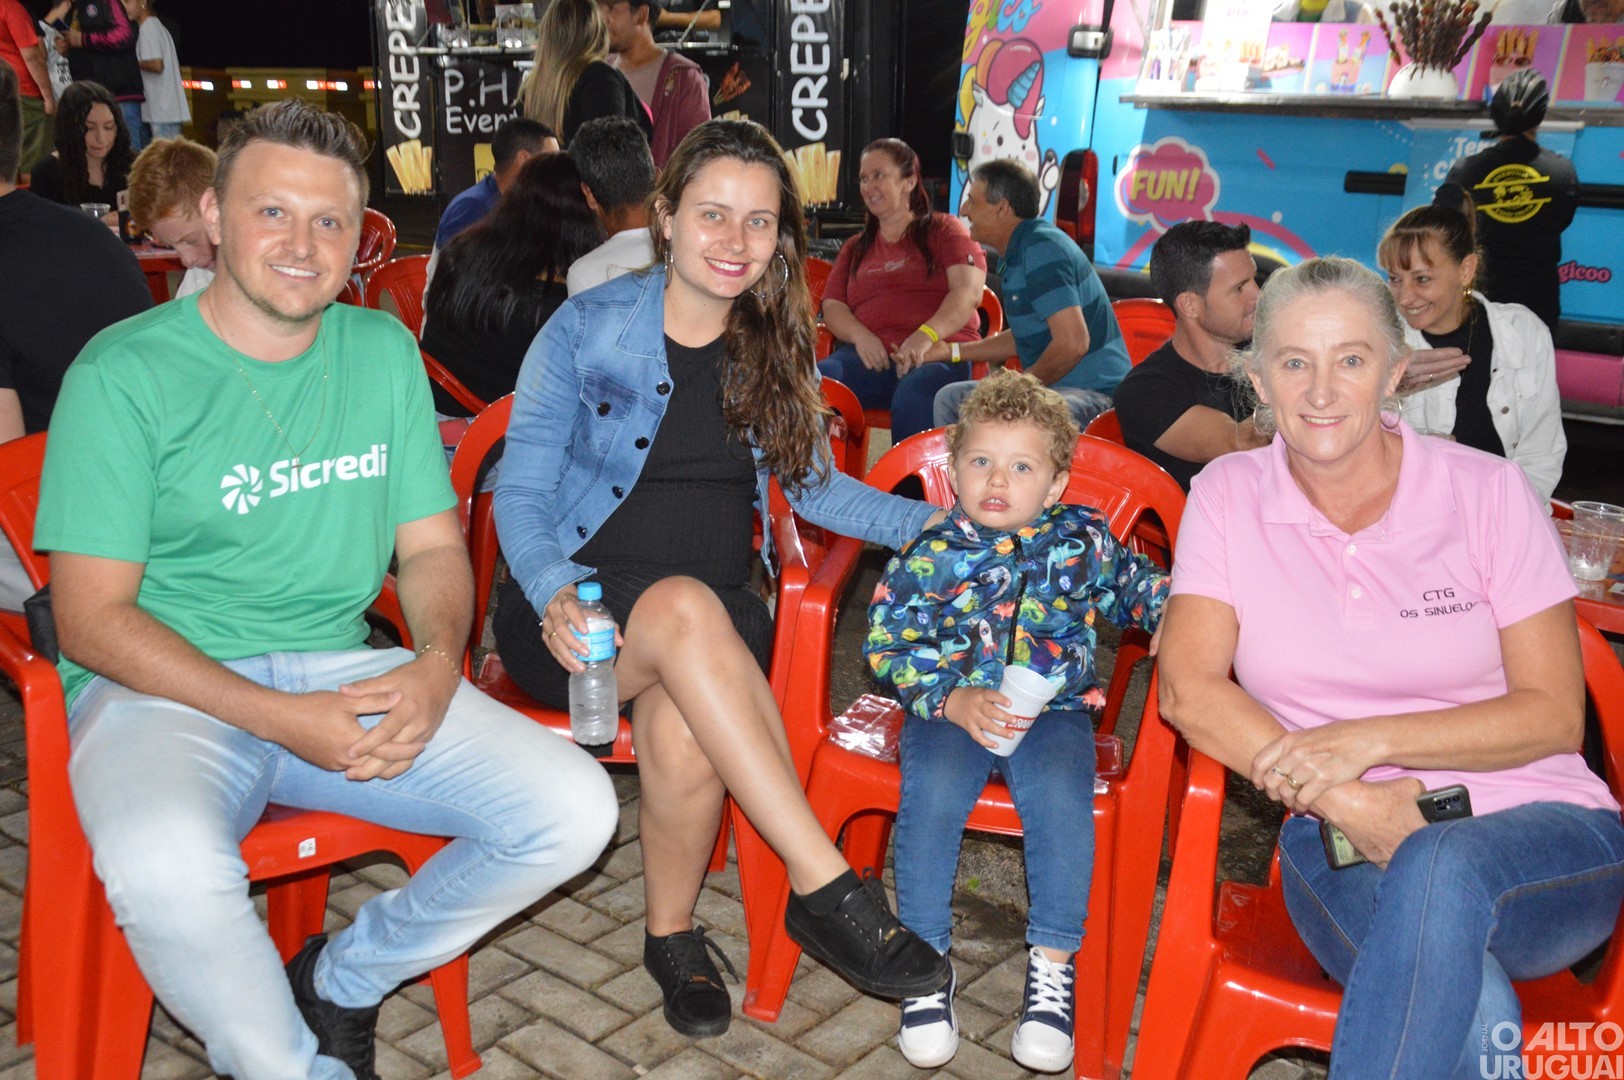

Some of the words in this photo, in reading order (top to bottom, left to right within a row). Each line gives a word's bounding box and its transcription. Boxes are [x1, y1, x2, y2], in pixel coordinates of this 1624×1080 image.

[446, 106, 518, 134] Even
[1131, 167, 1201, 201] FUN!
[269, 444, 387, 498] Sicredi
[1423, 587, 1455, 602] CTG
[1400, 609, 1418, 618] OS
[1424, 602, 1478, 617] SINUELO
